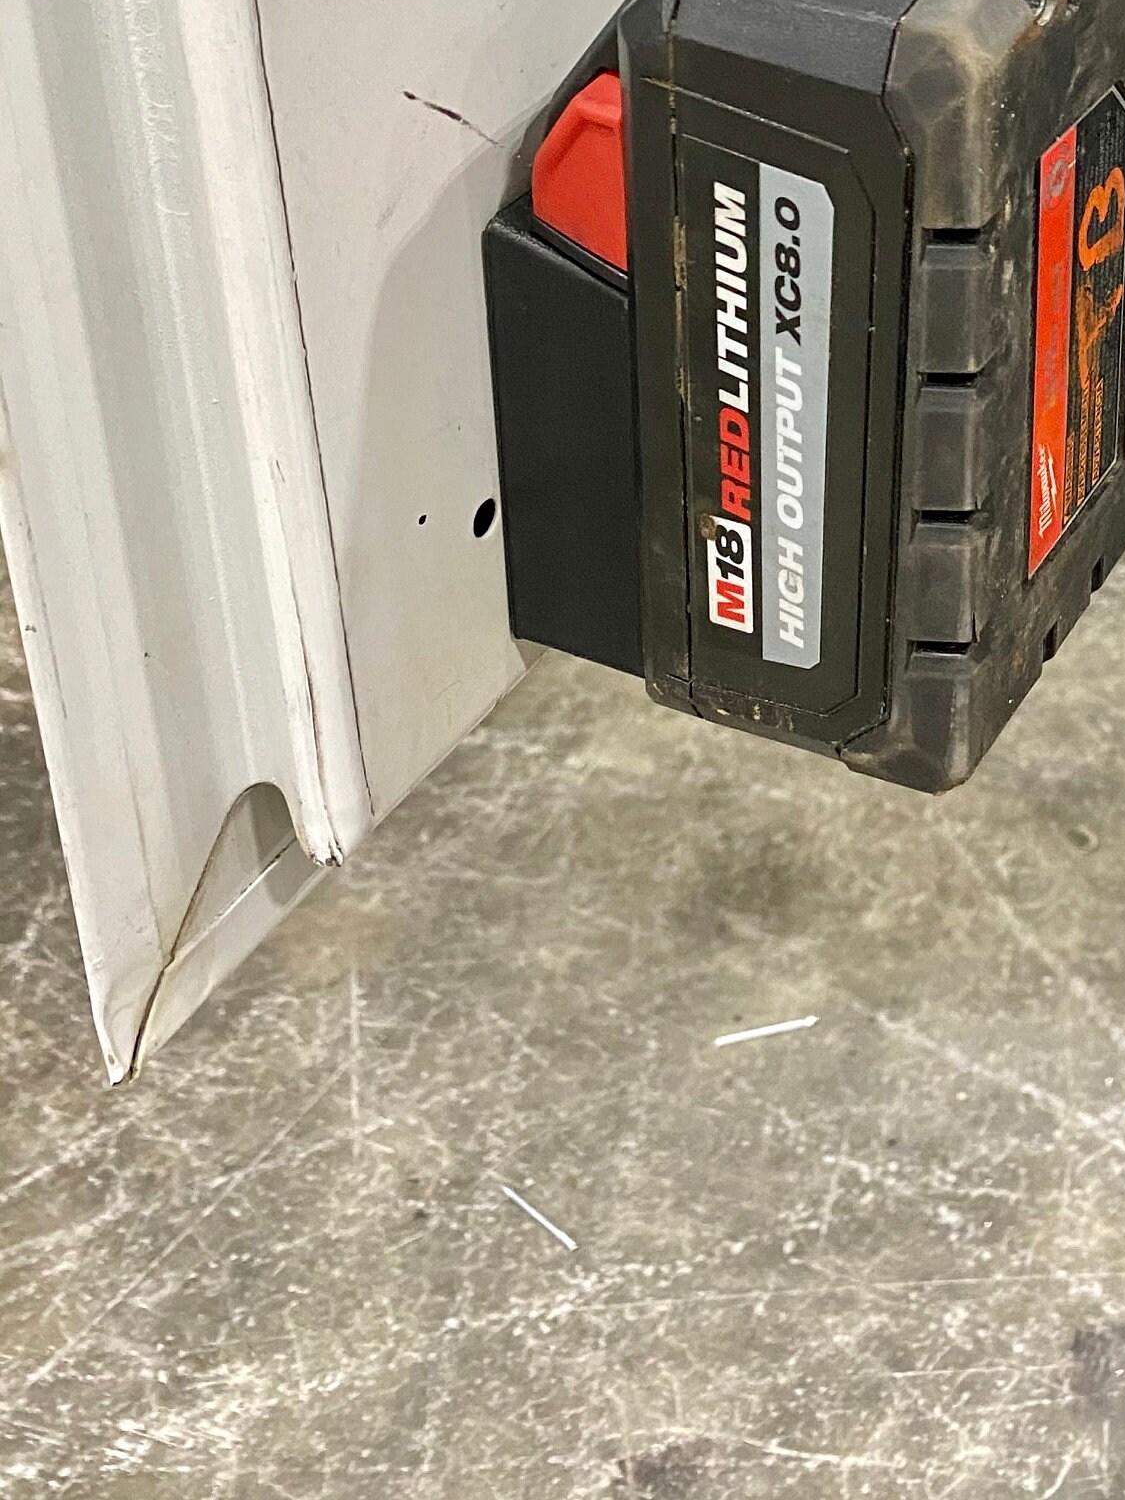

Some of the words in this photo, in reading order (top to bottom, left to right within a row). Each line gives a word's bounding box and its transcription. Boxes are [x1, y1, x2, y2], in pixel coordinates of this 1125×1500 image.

[774, 196, 802, 347] XC8.0
[713, 181, 751, 522] REDLITHIUM
[774, 347, 804, 530] OUTPUT
[1037, 442, 1053, 539] Milwaukee
[715, 524, 746, 624] M18
[778, 536, 805, 649] HIGH
